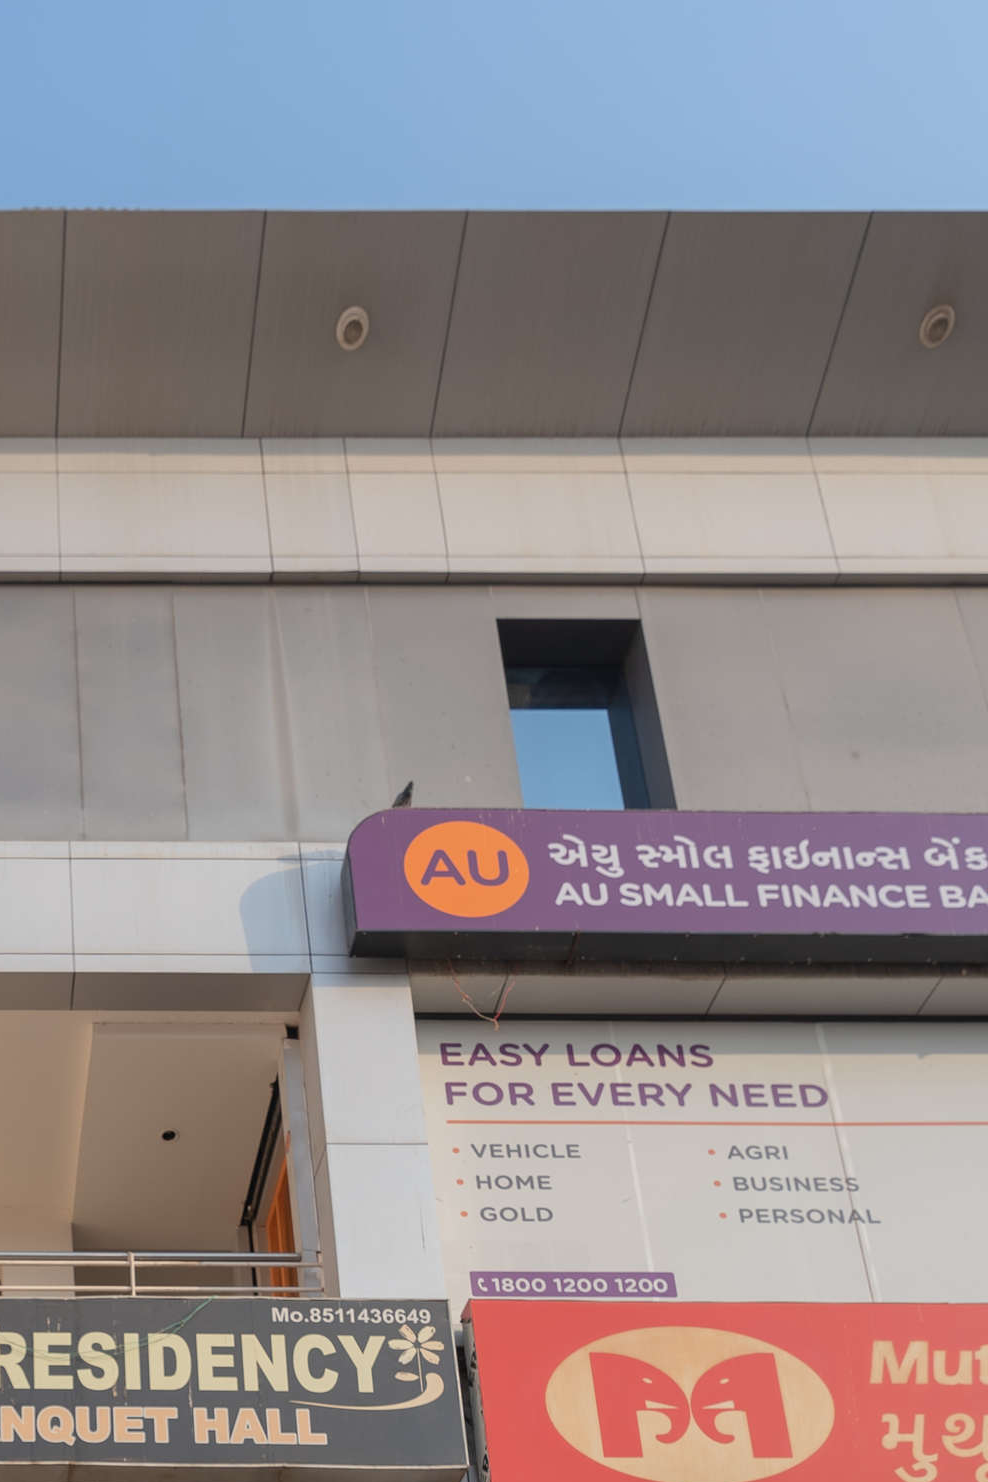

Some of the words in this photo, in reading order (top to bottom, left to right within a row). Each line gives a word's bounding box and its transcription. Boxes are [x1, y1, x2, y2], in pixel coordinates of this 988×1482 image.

[548, 834, 624, 878] એયુ
[636, 835, 734, 868] સ્મોલ
[421, 850, 510, 886] AU
[555, 882, 609, 906] AU
[619, 883, 748, 907] SMALL
[757, 884, 931, 909] FINANCE
[939, 884, 988, 909] BA
[439, 1043, 549, 1067] EASY
[566, 1044, 714, 1068] LOANS
[444, 1081, 535, 1106] FOR
[551, 1082, 692, 1107] EVERY
[709, 1083, 828, 1108] NEED
[471, 1143, 581, 1159] VEHICLE
[727, 1145, 789, 1160] AGRI
[475, 1175, 552, 1191] HOME
[732, 1176, 859, 1193] BUSINESS
[479, 1207, 553, 1223] GOLD
[738, 1208, 881, 1225] PERSONAL
[491, 1277, 546, 1293] 1800
[553, 1277, 608, 1294] 1200
[614, 1277, 669, 1294] 1200
[193, 1407, 328, 1445] HALL
